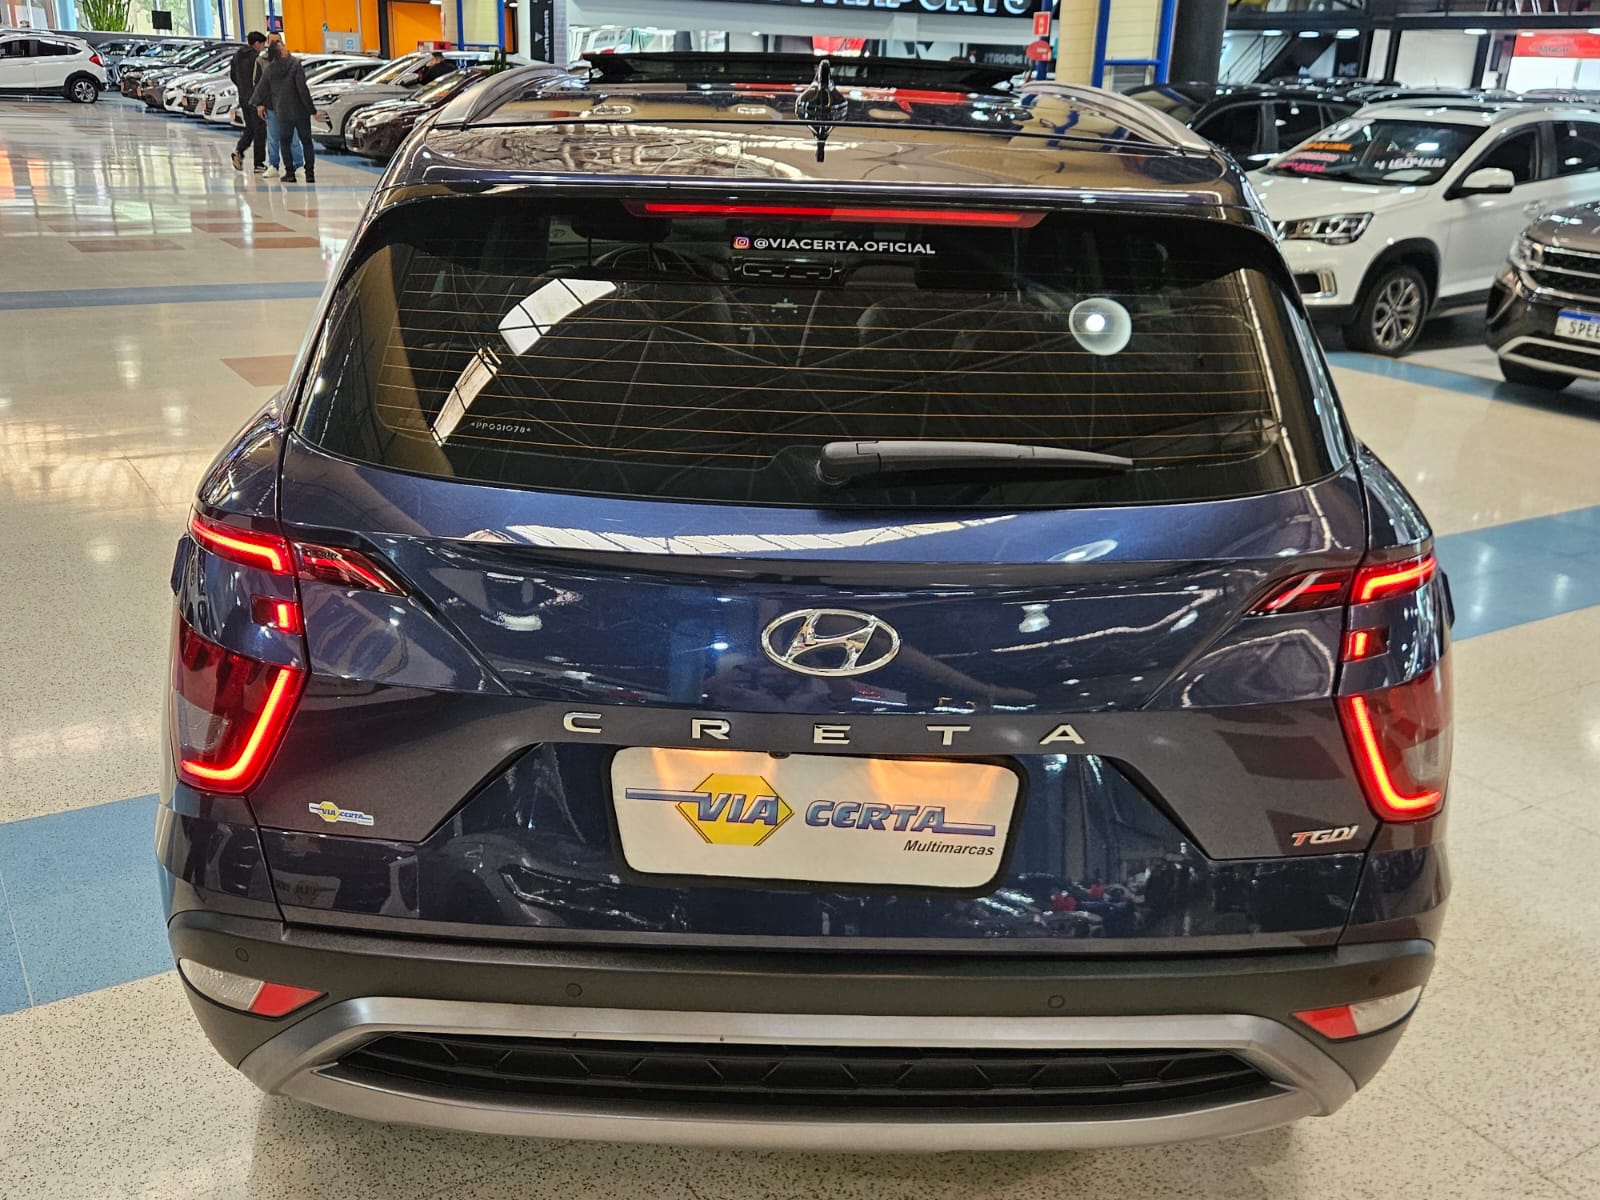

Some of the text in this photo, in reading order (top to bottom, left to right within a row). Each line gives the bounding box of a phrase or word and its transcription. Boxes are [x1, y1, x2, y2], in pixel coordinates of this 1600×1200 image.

[753, 237, 936, 255] @VIACERTA.OFICIAL
[563, 711, 1086, 746] CRETA
[321, 808, 363, 819] VIA CERTA
[697, 793, 946, 834] VIA CERTA
[1291, 825, 1360, 847] TGDI
[903, 839, 995, 857] Multimarcas
